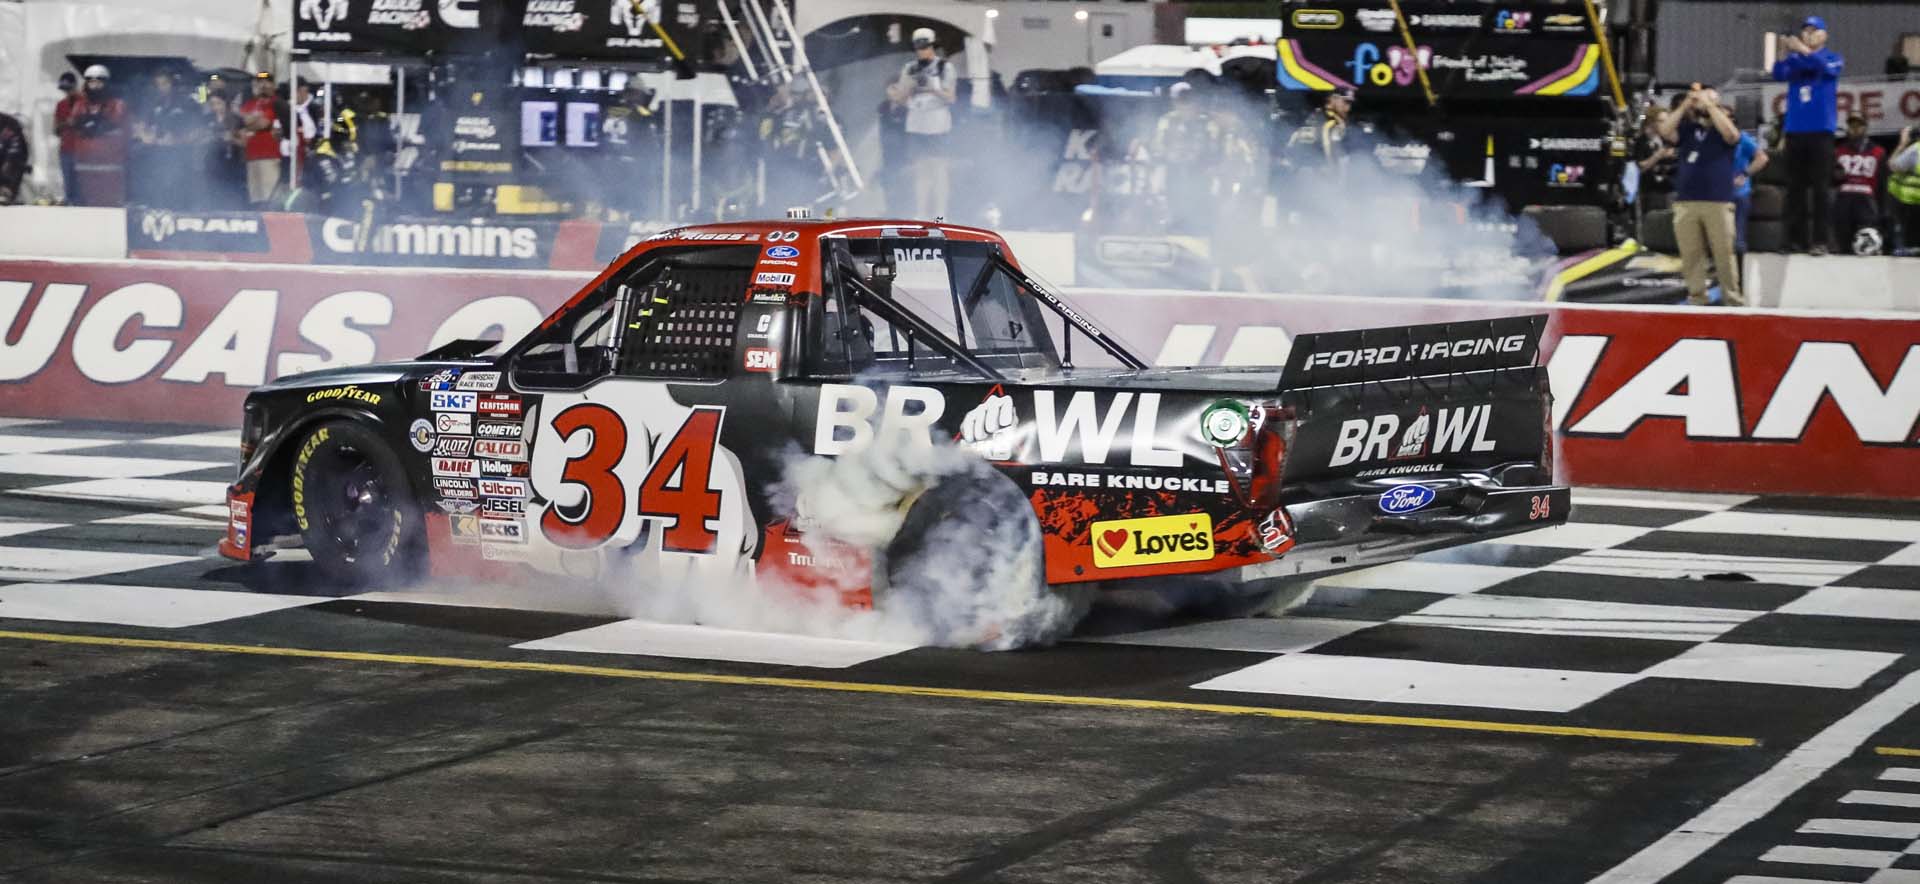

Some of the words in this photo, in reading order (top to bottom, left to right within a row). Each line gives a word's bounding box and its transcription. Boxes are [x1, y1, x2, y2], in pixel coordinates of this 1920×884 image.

[177, 219, 258, 234] RAM
[759, 274, 781, 282] Mobil
[1025, 277, 1058, 304] FORD
[1057, 302, 1101, 336] RACING
[746, 350, 778, 369] SEM
[1304, 345, 1402, 371] FORD
[1405, 334, 1526, 362] RACING
[475, 381, 495, 389] TRUCK
[306, 384, 382, 405] GOODYEAR
[433, 394, 475, 408] SKF
[479, 401, 520, 411] CRAFTSMAN
[478, 424, 522, 436] COMETIC
[439, 438, 469, 452] KLOTZ
[476, 441, 521, 455] CALICO
[482, 460, 512, 477] Holley
[1355, 469, 1387, 478] BARE
[1388, 463, 1445, 475] KNUCKLE
[293, 427, 330, 531] GOODYEAR
[435, 479, 469, 488] LINCOLN
[540, 402, 727, 554] 34
[1031, 471, 1100, 488] BARE
[1107, 474, 1230, 494] KNUCKLE
[443, 488, 474, 497] WELDERS
[481, 482, 523, 495] tilton
[1389, 487, 1425, 510] Ford
[484, 500, 525, 513] JESEL
[1530, 494, 1550, 520] 34
[482, 523, 519, 536] KKS
